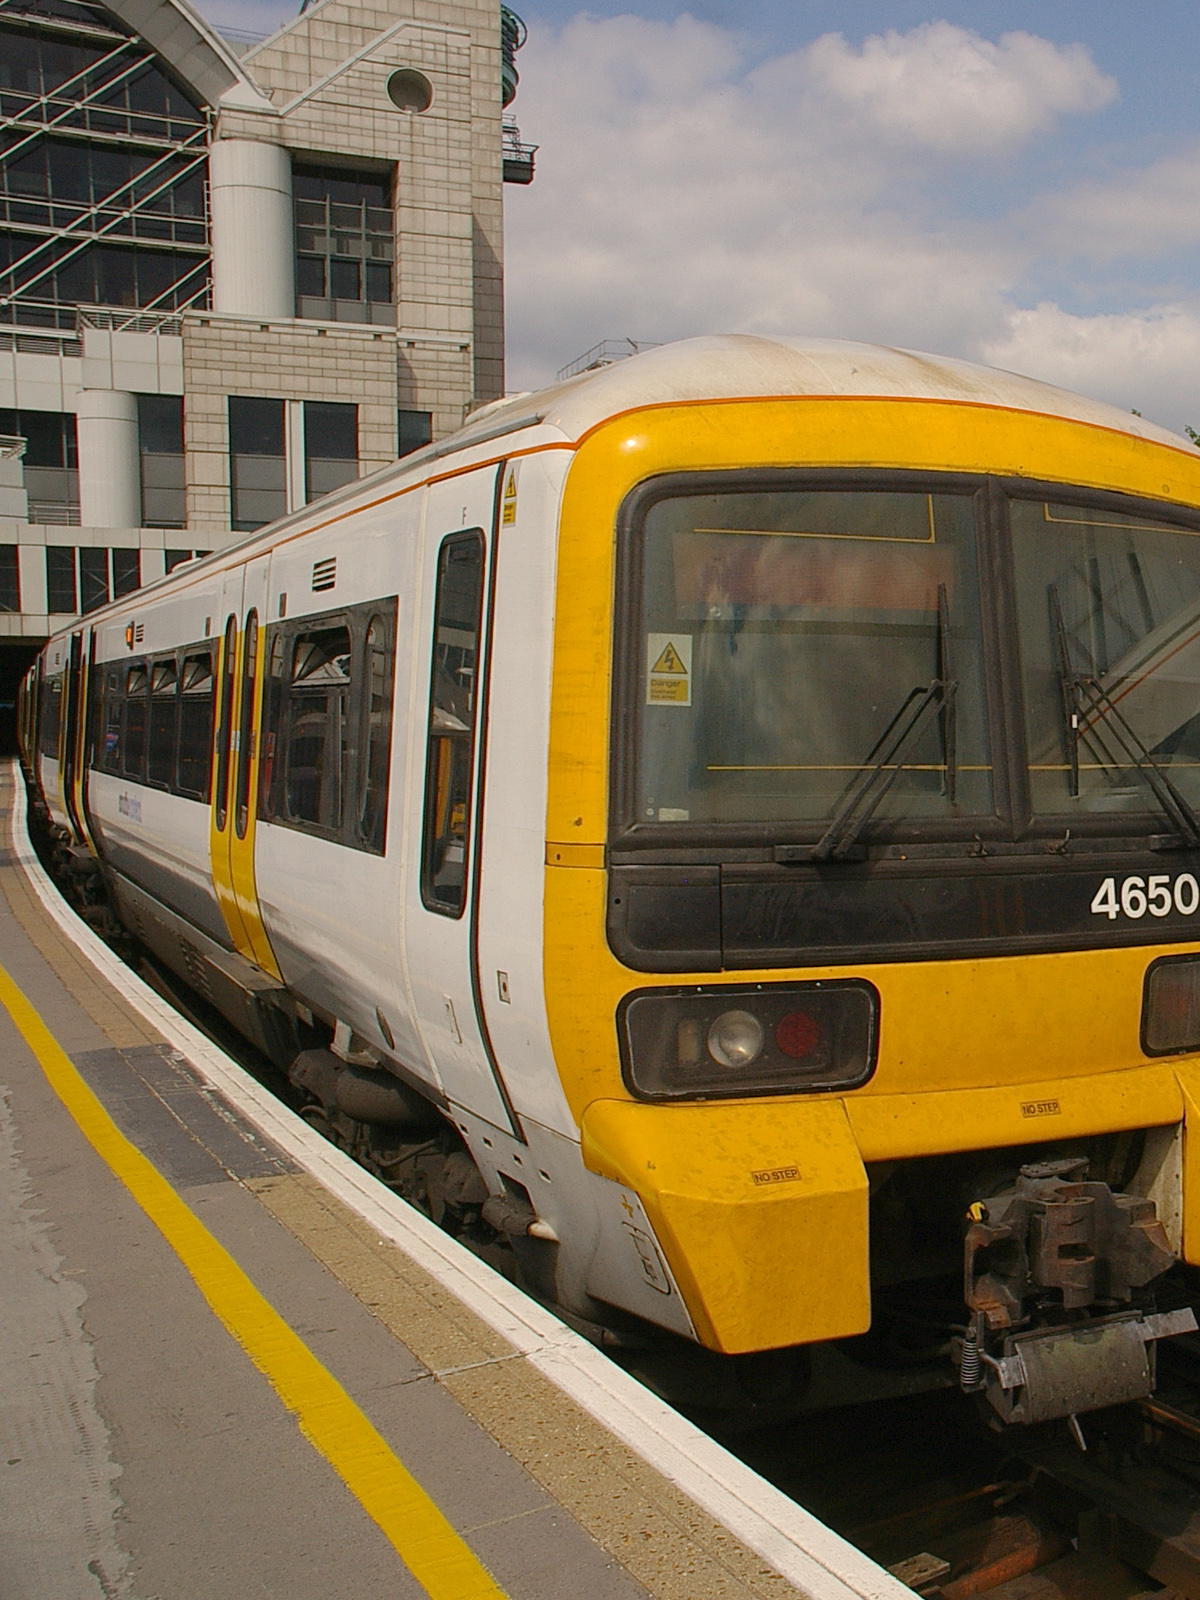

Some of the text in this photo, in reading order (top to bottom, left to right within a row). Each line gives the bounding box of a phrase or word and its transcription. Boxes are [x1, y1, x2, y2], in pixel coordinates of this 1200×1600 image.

[1022, 1102, 1058, 1114] NO STEP
[754, 1169, 798, 1182] NO STEP
